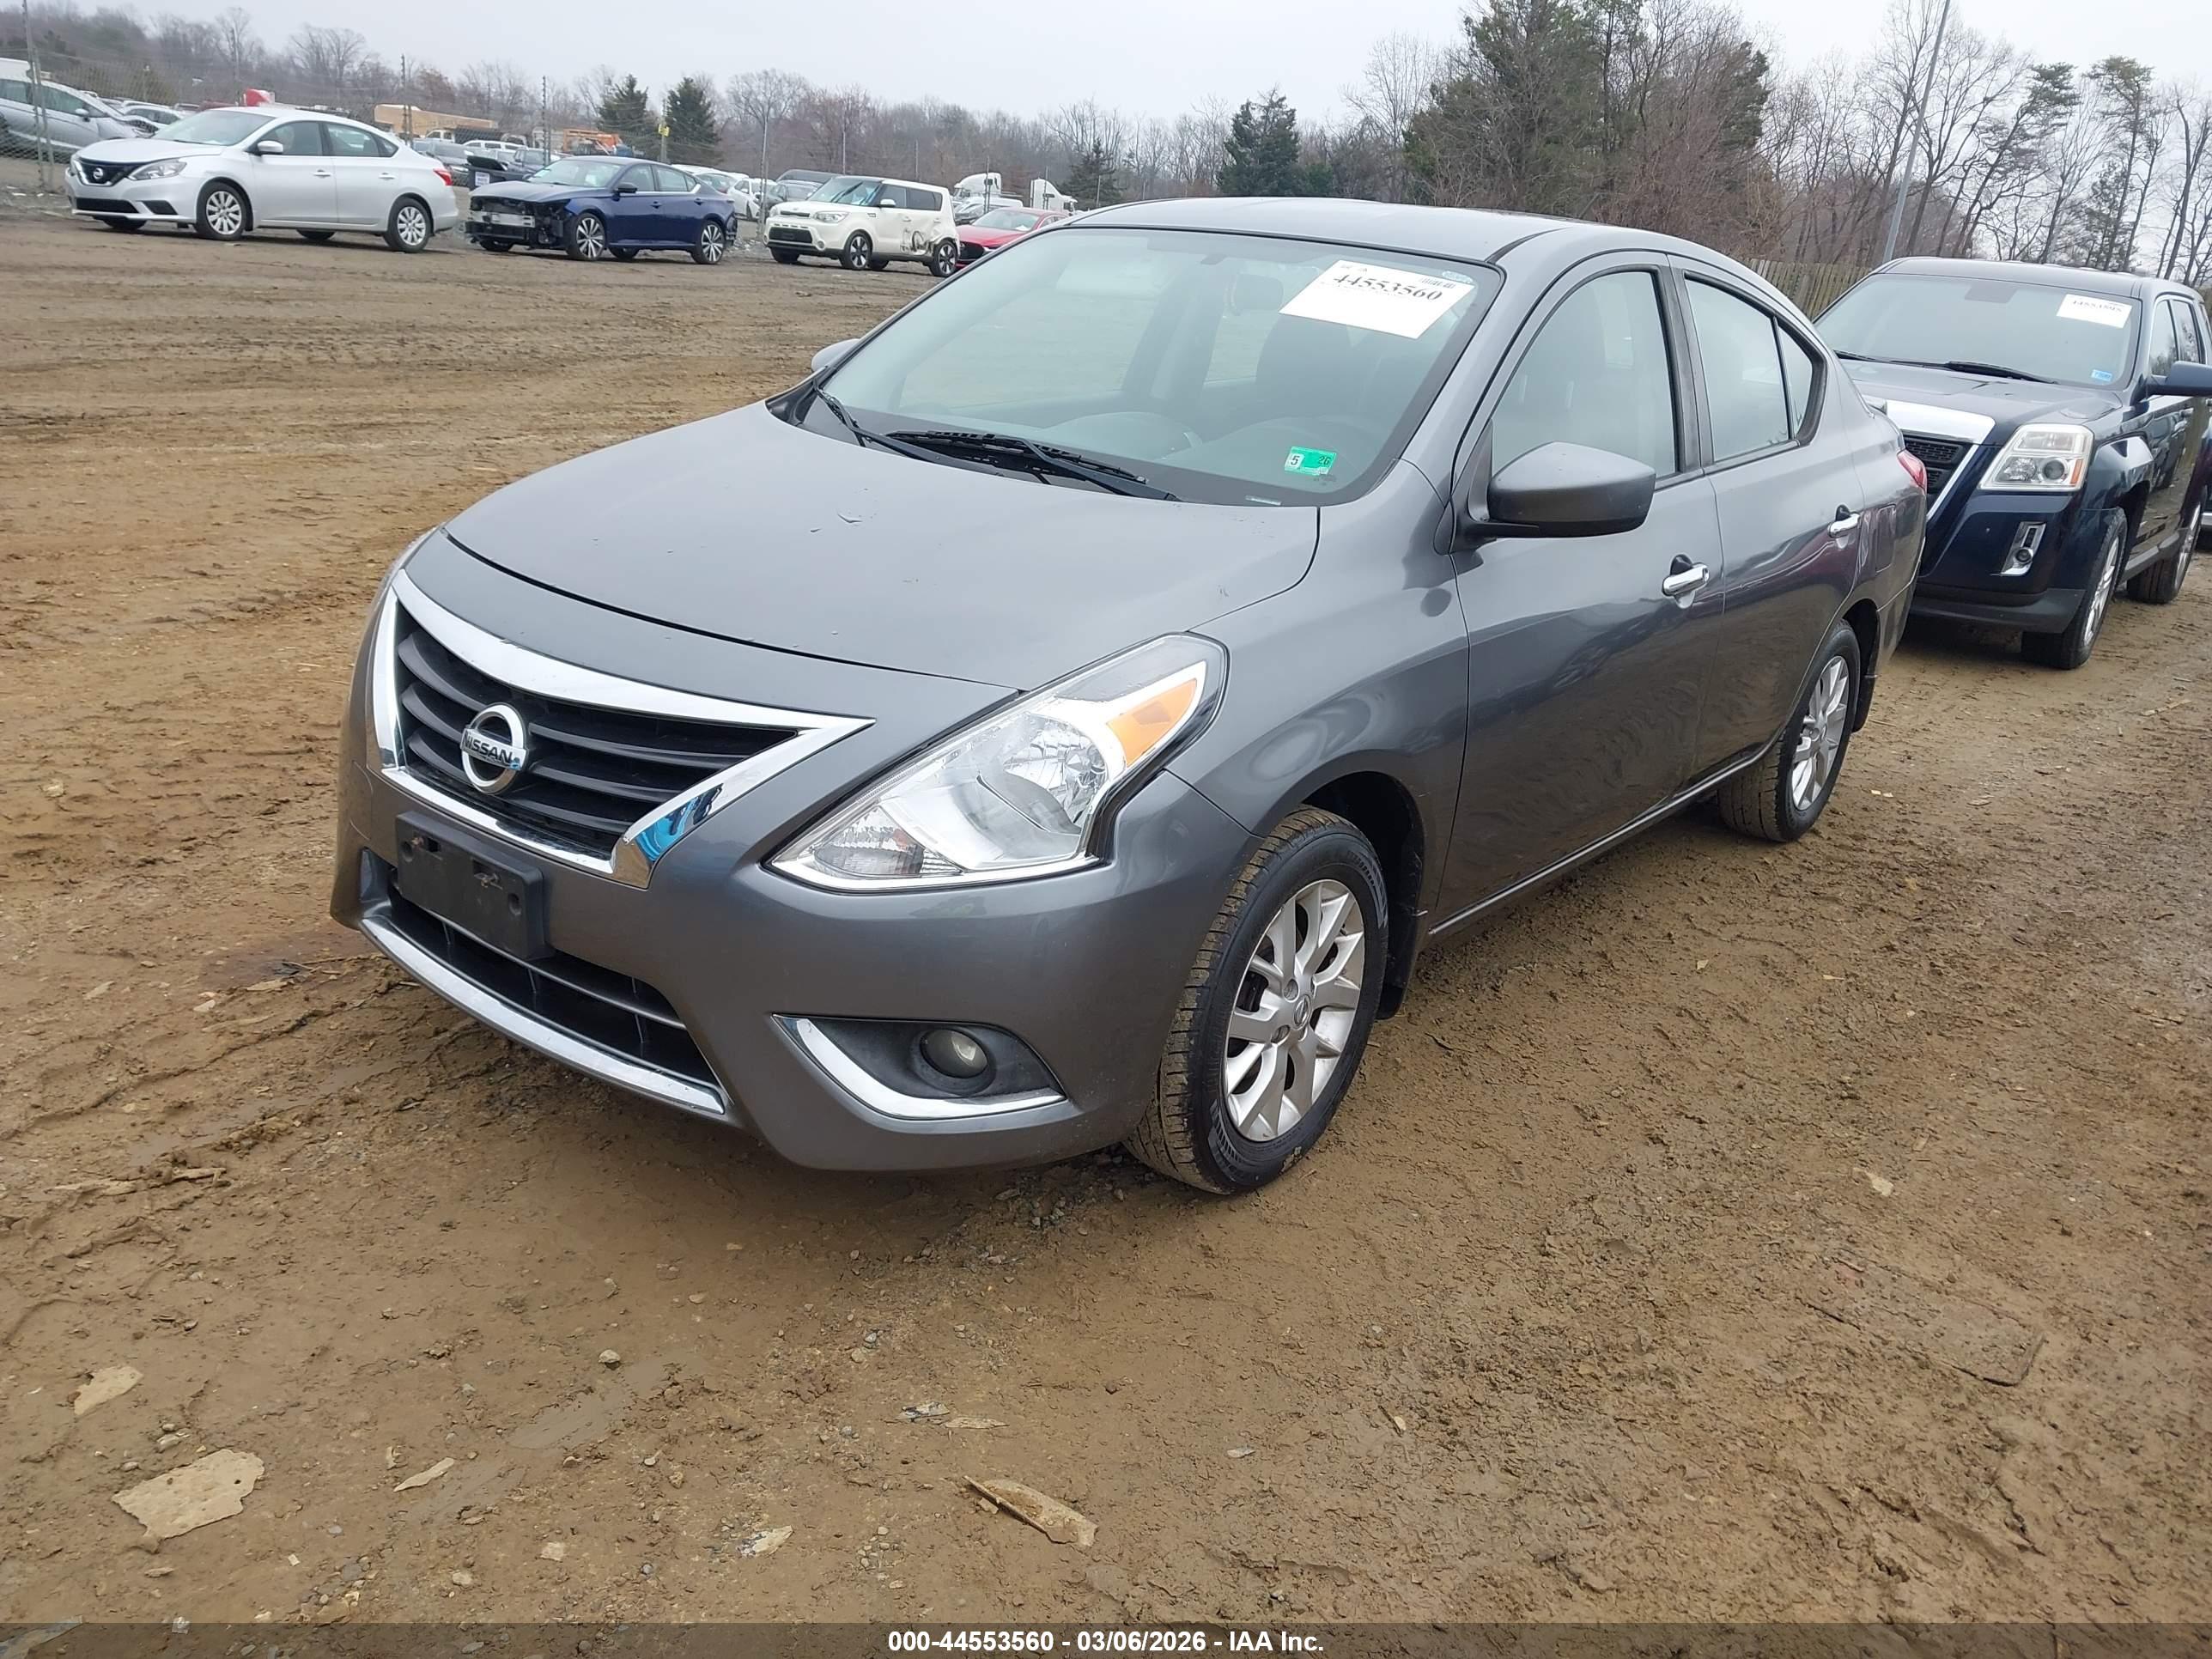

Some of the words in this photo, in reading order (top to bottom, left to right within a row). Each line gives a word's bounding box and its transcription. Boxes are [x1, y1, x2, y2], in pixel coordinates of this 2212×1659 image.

[1333, 273, 1443, 301] 44553560
[1291, 455, 1300, 465] 5
[461, 731, 513, 765] NISSAN
